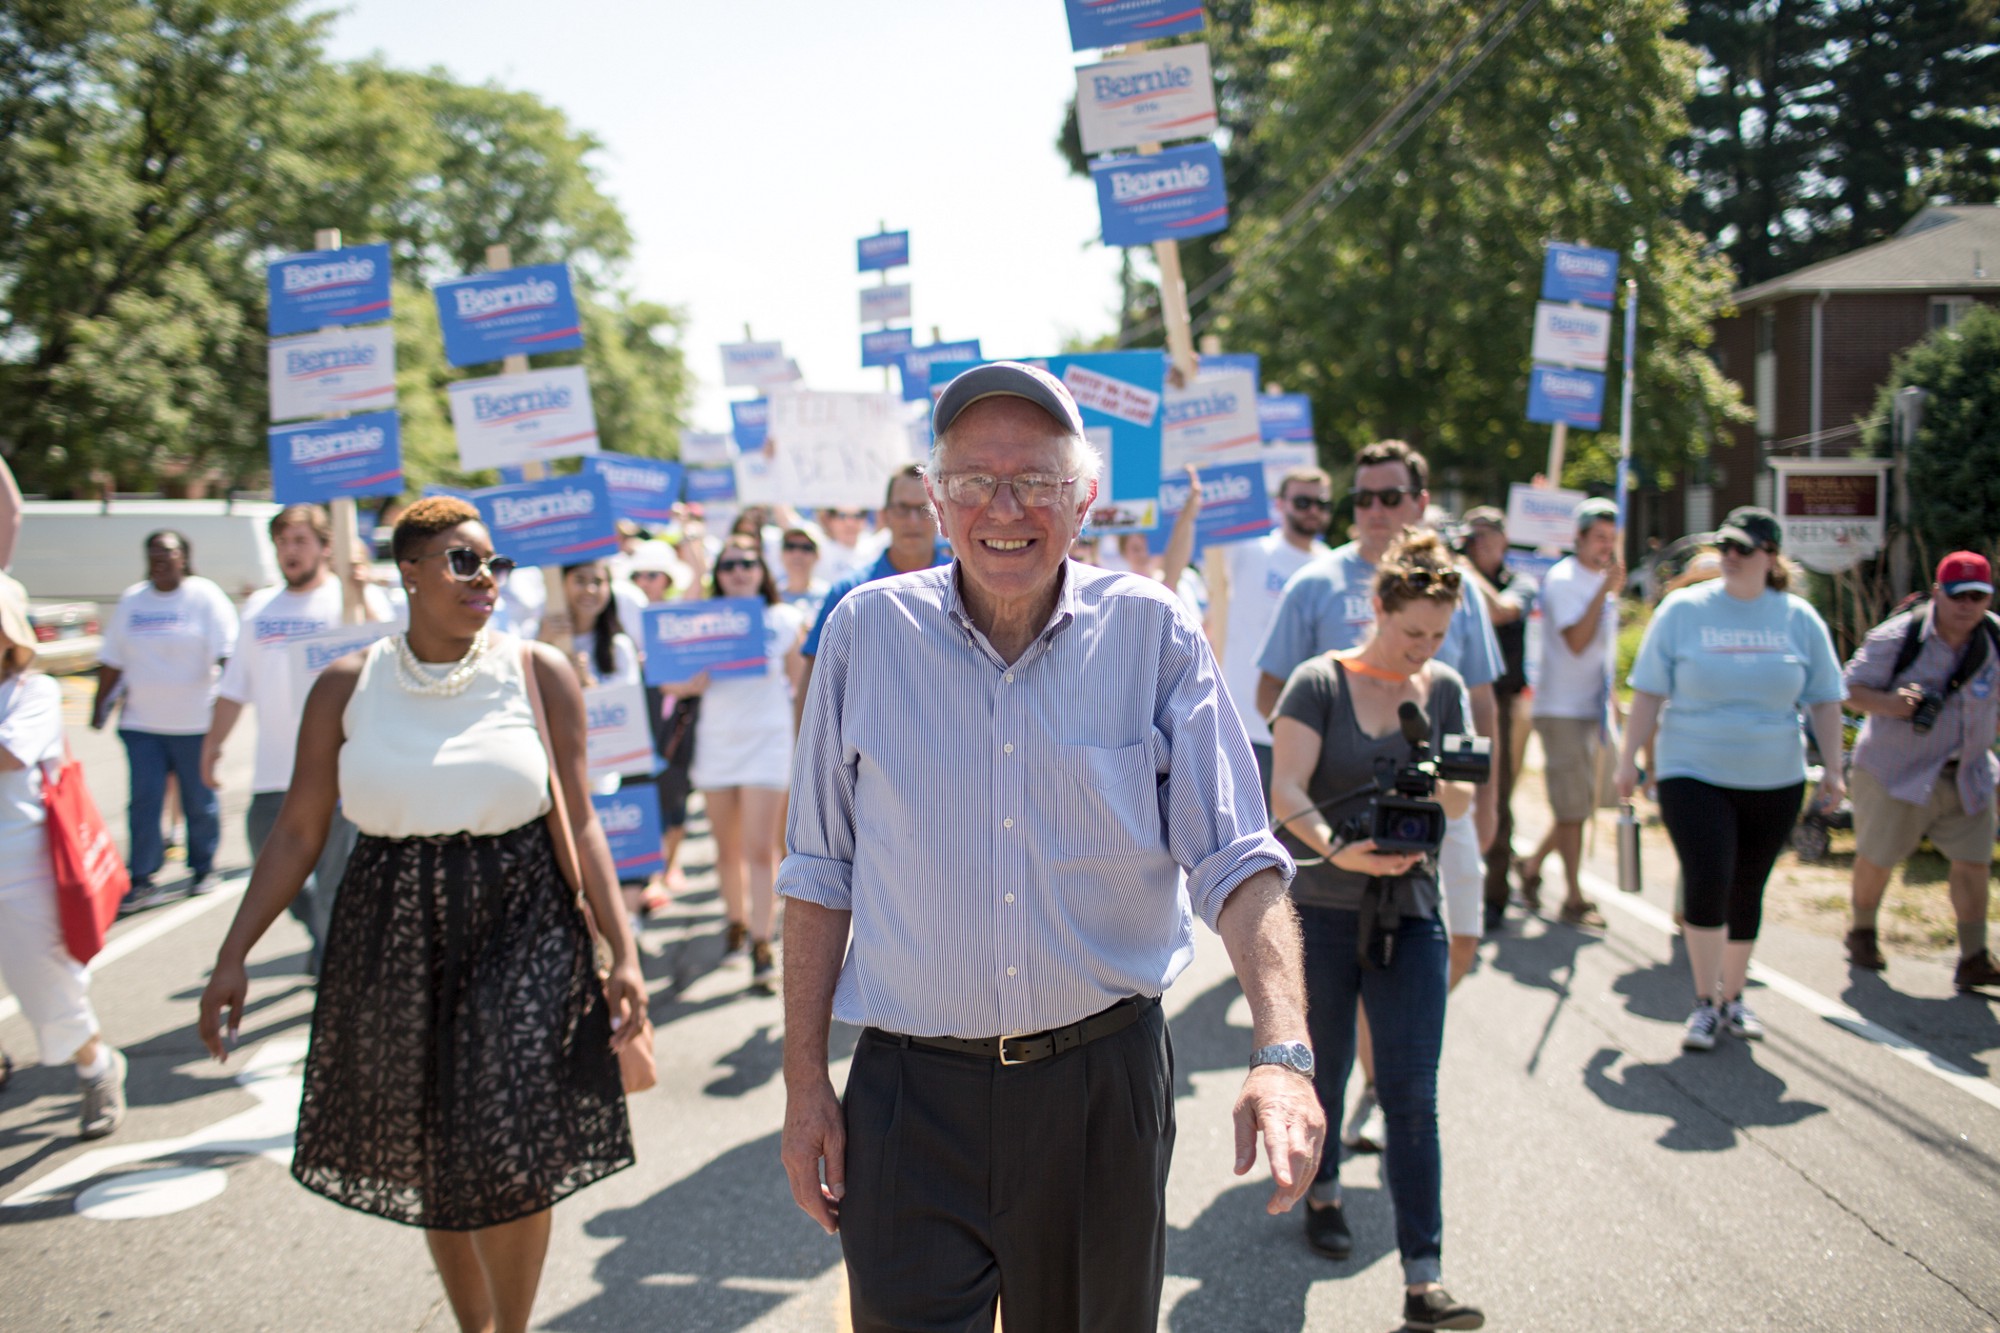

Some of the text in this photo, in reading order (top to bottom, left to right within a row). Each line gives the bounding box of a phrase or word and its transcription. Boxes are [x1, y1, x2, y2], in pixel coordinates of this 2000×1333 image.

[1091, 61, 1192, 101] Bernie
[1110, 161, 1210, 201] Bernie
[282, 257, 375, 291] Bernie
[1556, 250, 1609, 277] Bernie
[455, 278, 558, 316] Bernie
[1548, 314, 1600, 338] Bernie
[286, 341, 376, 374] Bernie
[473, 384, 571, 420] Bernie
[1541, 373, 1596, 398] Bernie
[1163, 390, 1238, 421] ernie
[290, 425, 385, 461] Bernie
[492, 488, 595, 527] Bernie
[1160, 474, 1251, 508] Benie
[656, 609, 751, 641] Bernie
[1700, 626, 1791, 649] Bernie
